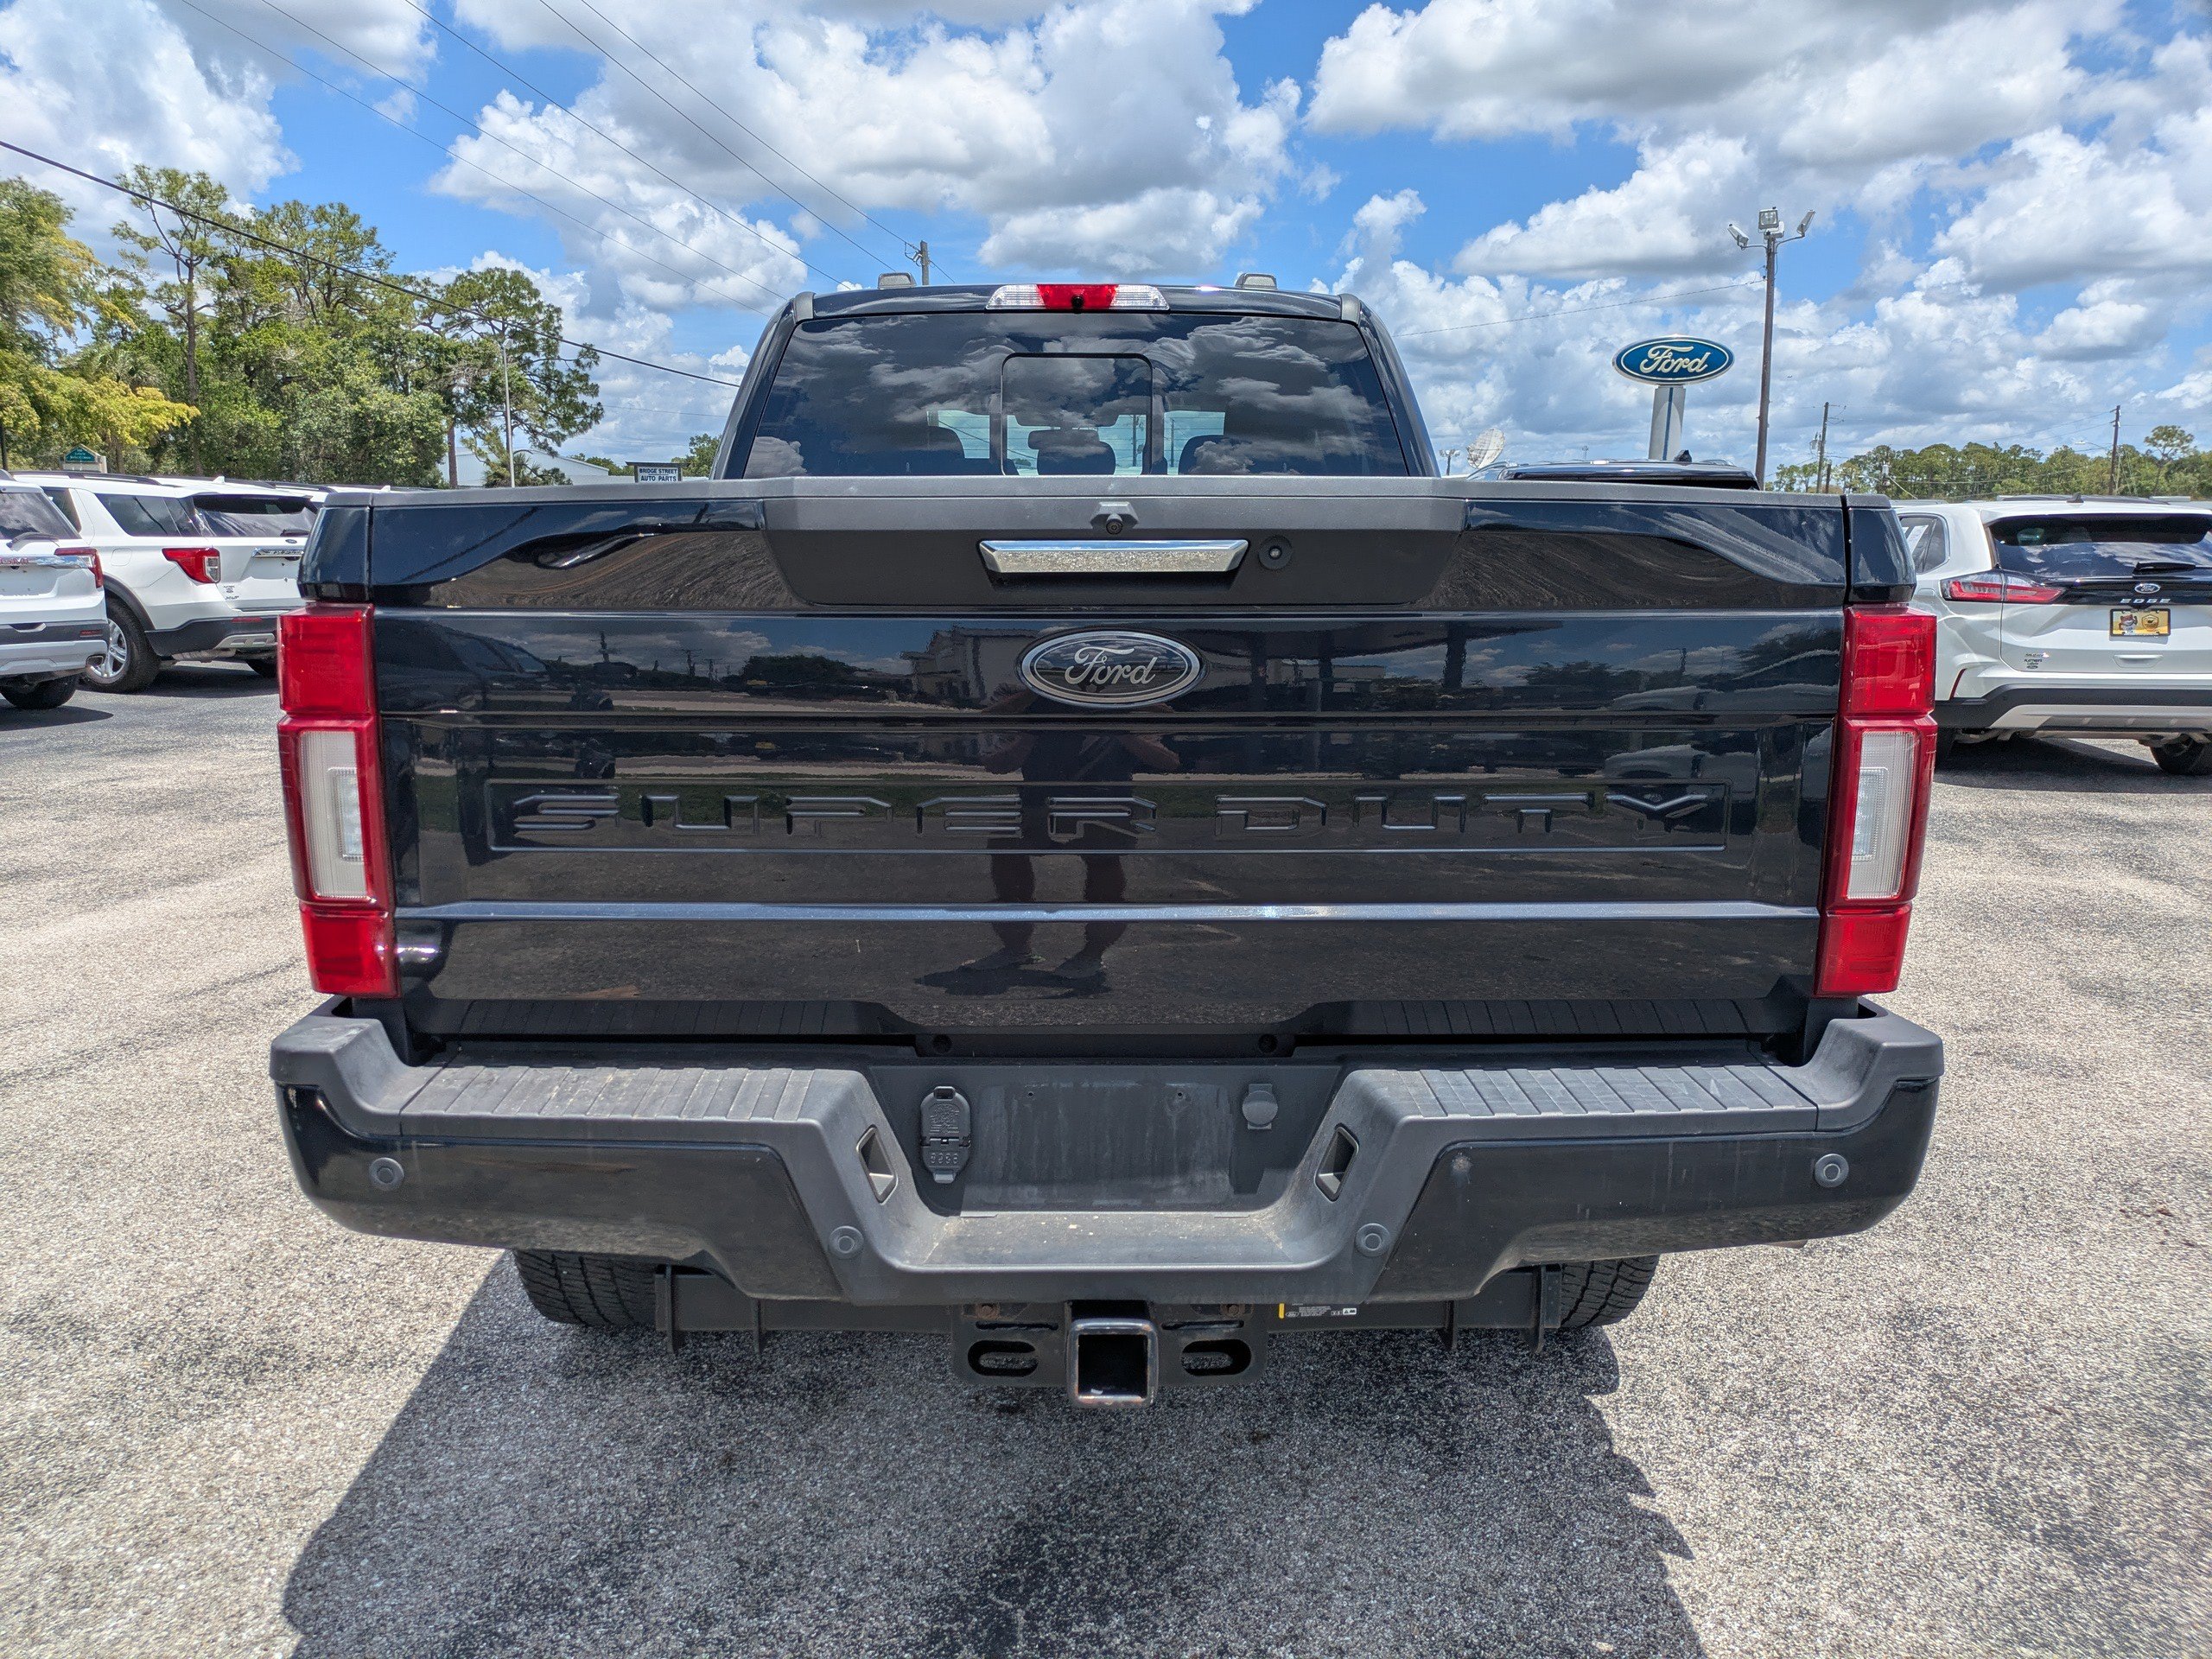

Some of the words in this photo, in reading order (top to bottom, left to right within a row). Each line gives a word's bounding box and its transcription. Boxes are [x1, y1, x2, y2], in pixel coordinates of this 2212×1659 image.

[1639, 345, 1712, 373] Ford
[1065, 646, 1158, 684] Ford
[512, 794, 1158, 840] SUPER
[1213, 792, 1709, 842] DUTY
